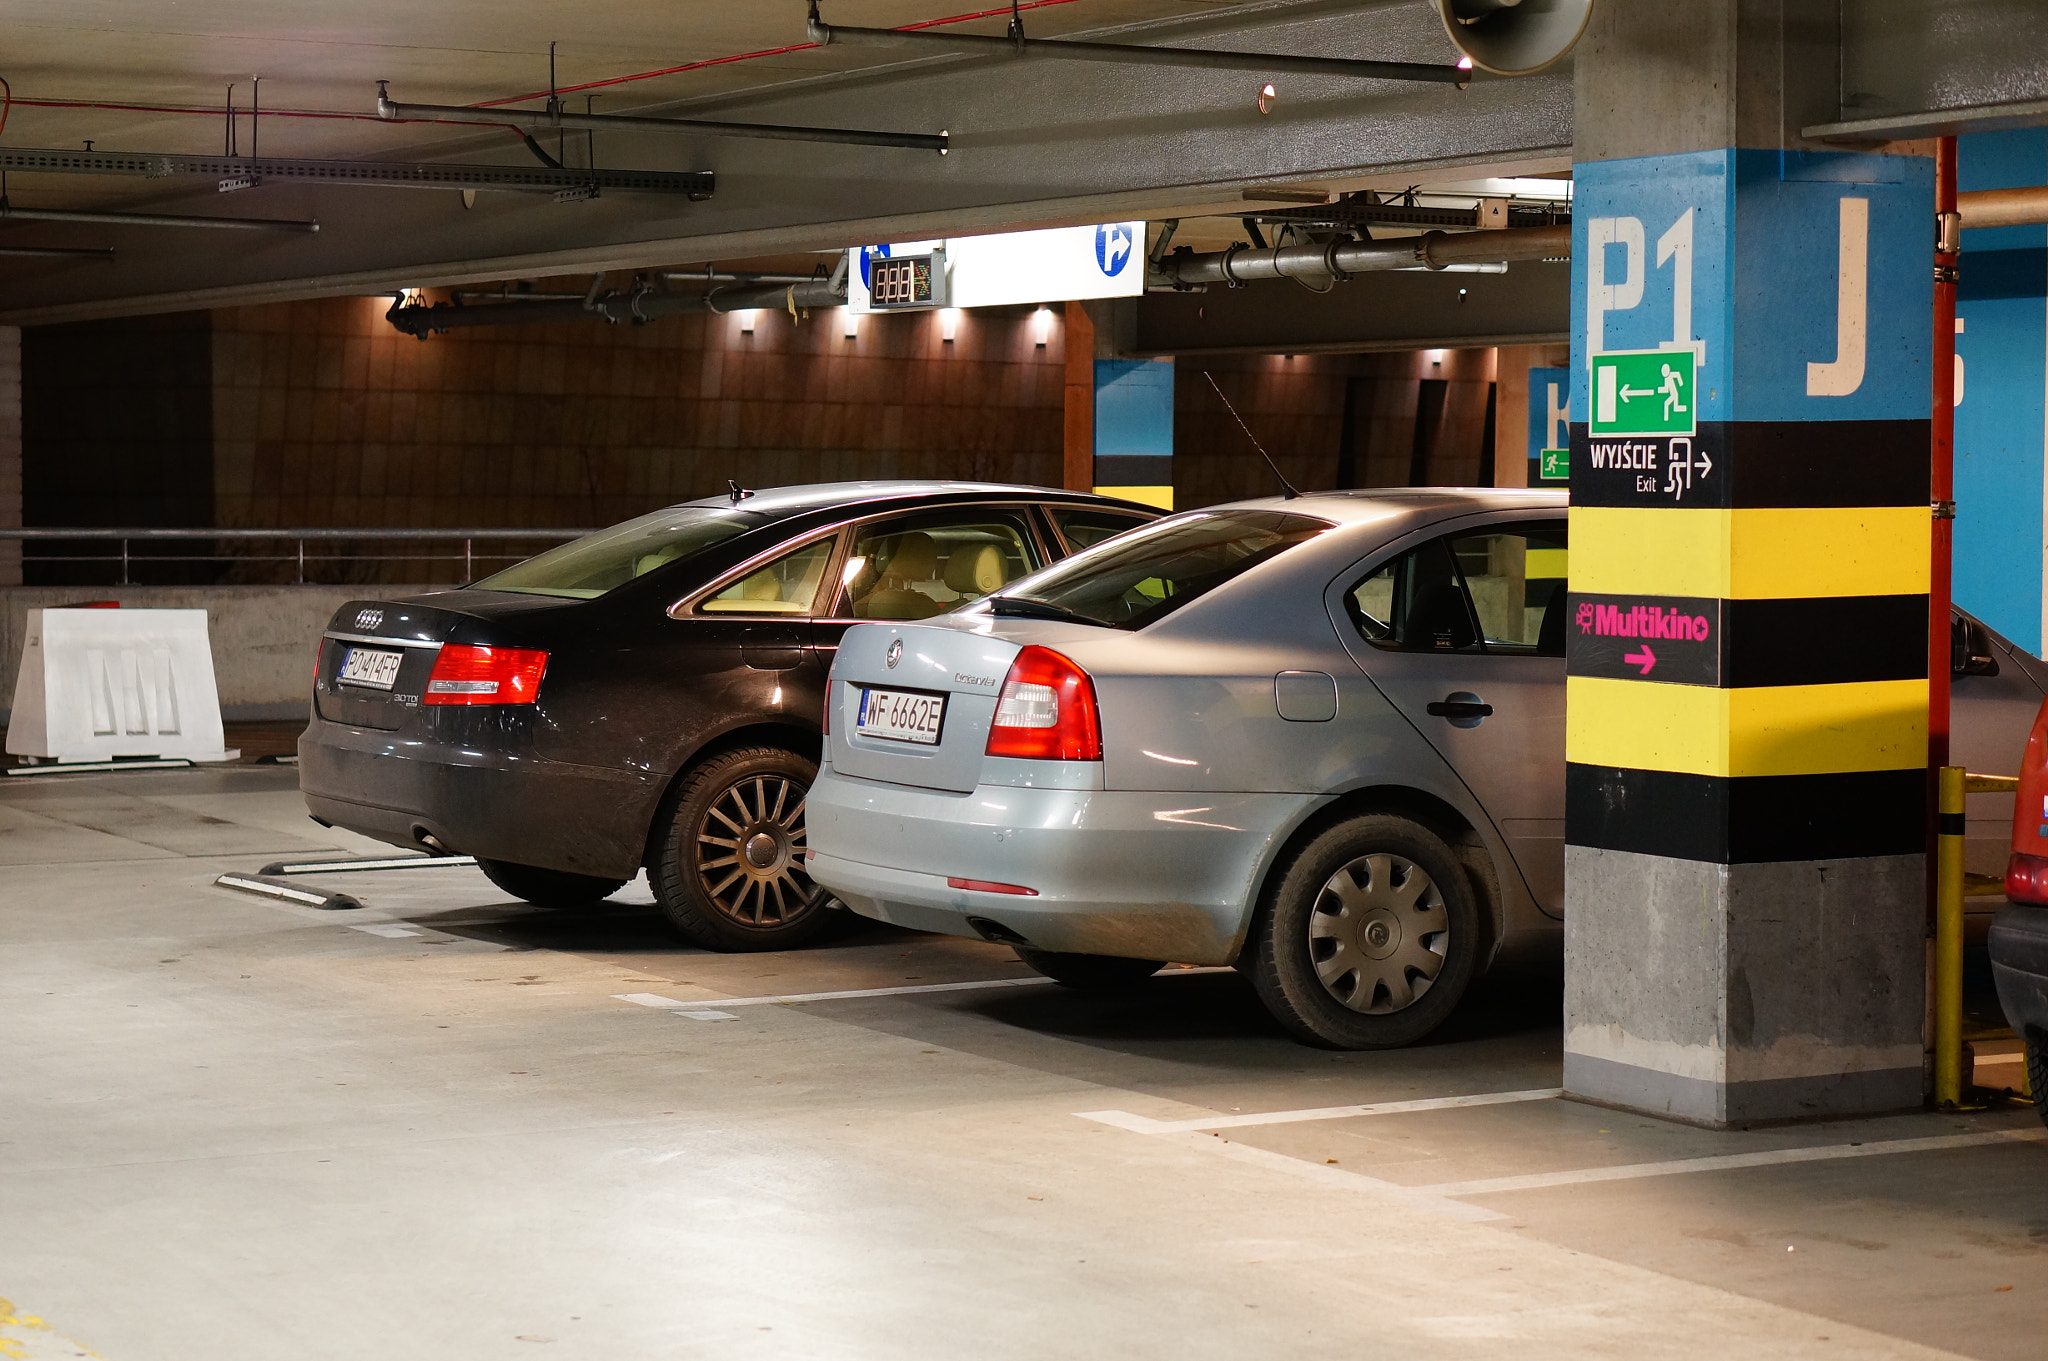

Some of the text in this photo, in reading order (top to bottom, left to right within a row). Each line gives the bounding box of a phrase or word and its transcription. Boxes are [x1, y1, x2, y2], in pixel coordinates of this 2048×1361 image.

[1586, 206, 1705, 371] P1
[1806, 197, 1869, 397] J
[1590, 440, 1657, 469] WYJŚCIE
[1636, 475, 1657, 493] Exit
[1595, 604, 1709, 642] Multikino
[954, 672, 996, 687] Octavia
[867, 694, 941, 732] WF 6662E
